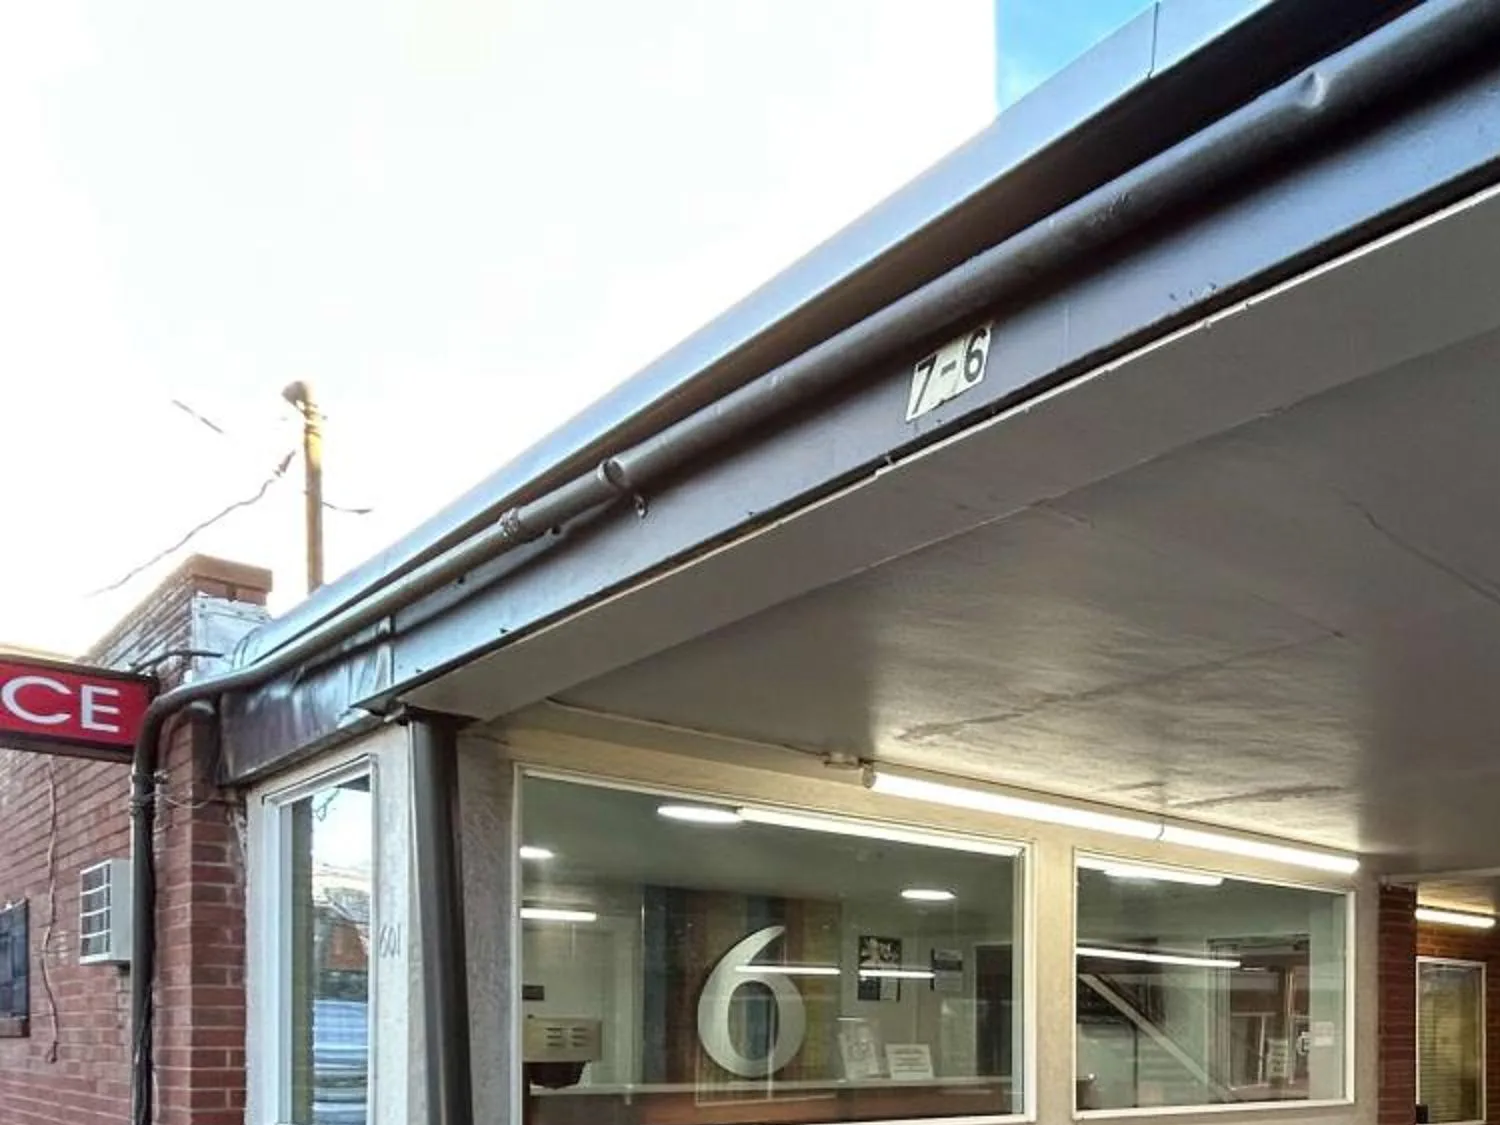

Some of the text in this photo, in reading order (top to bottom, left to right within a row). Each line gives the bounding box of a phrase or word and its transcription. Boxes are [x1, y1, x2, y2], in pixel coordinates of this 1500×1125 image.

[911, 326, 988, 416] 7-6
[1, 675, 120, 733] CE
[379, 921, 402, 959] 601
[697, 924, 807, 1079] 6
